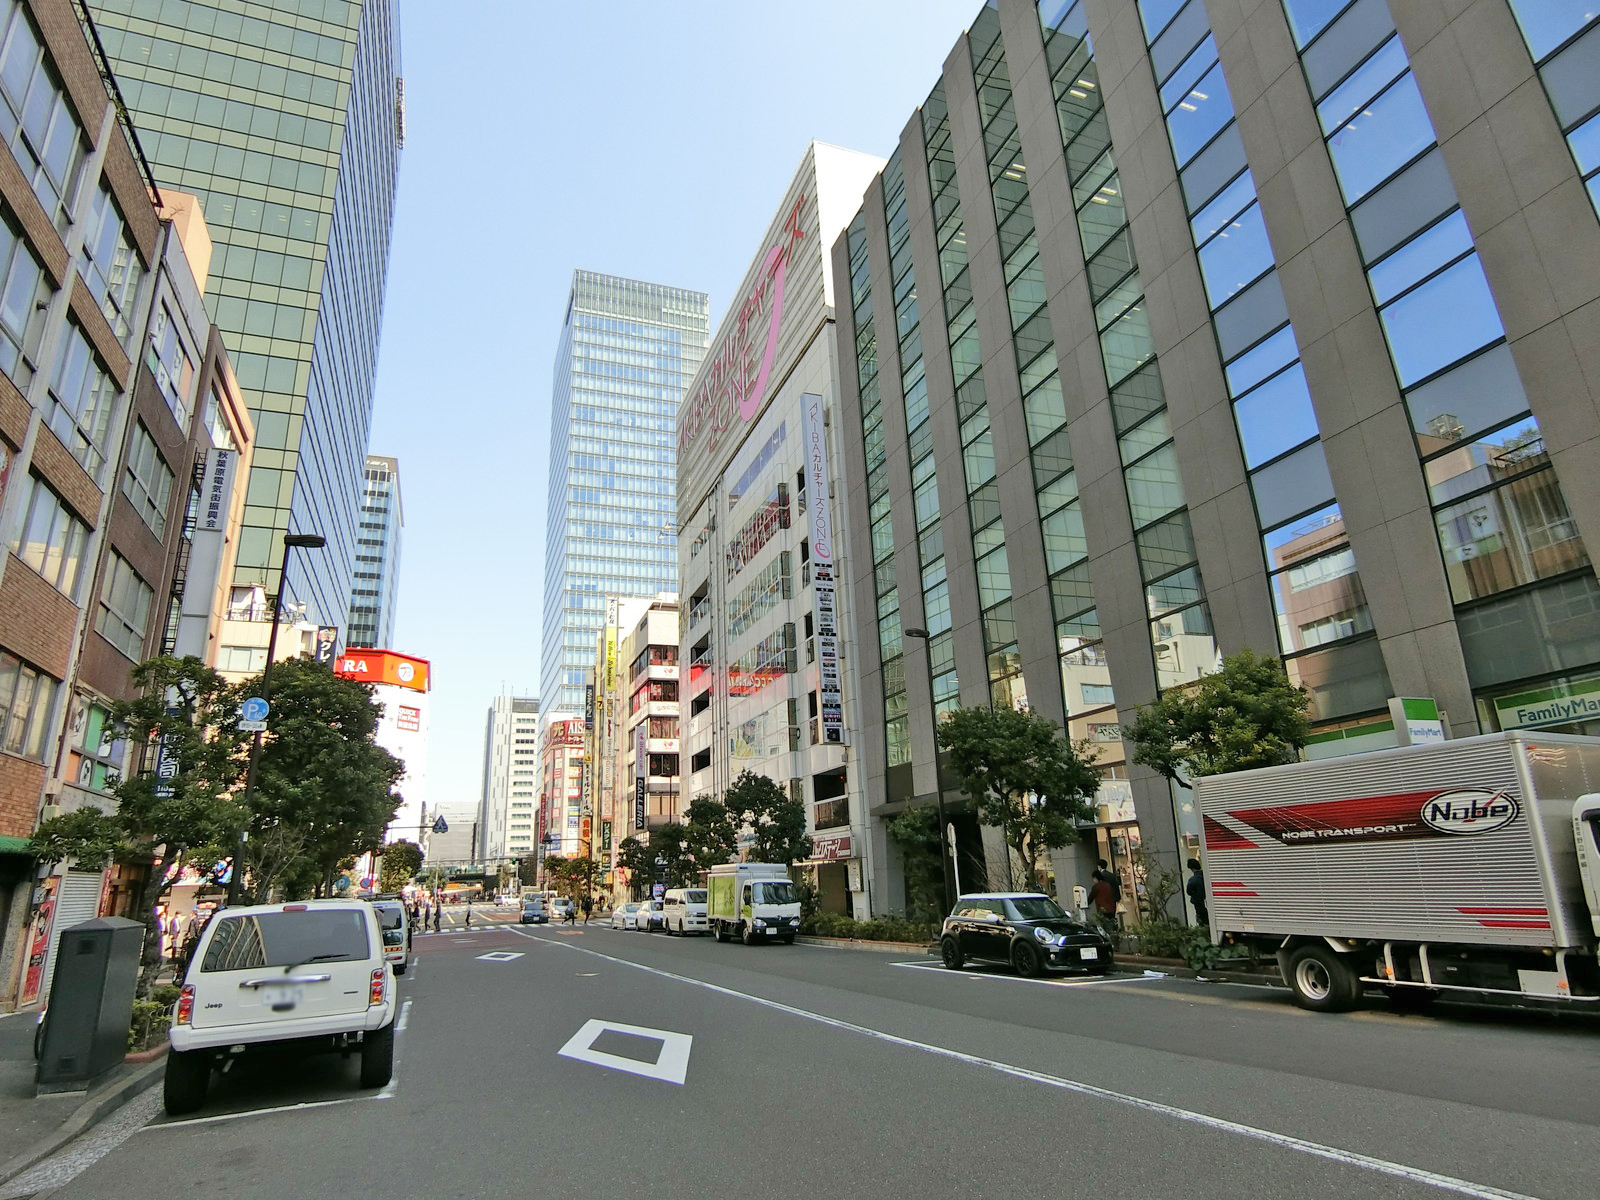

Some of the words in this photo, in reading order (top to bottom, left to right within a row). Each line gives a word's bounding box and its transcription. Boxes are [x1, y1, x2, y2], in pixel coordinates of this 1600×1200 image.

[708, 338, 756, 454] ZONE
[206, 451, 229, 528] 秋葉原電気街振興会
[247, 703, 259, 719] P
[1517, 697, 1600, 723] FamilyMa
[568, 721, 584, 734] AIS
[1409, 728, 1442, 737] FamilyMart
[1430, 800, 1508, 822] Nobe
[1281, 830, 1315, 840] NOBE
[1316, 825, 1406, 838] TRANSPORT
[204, 1001, 223, 1009] Jeep
